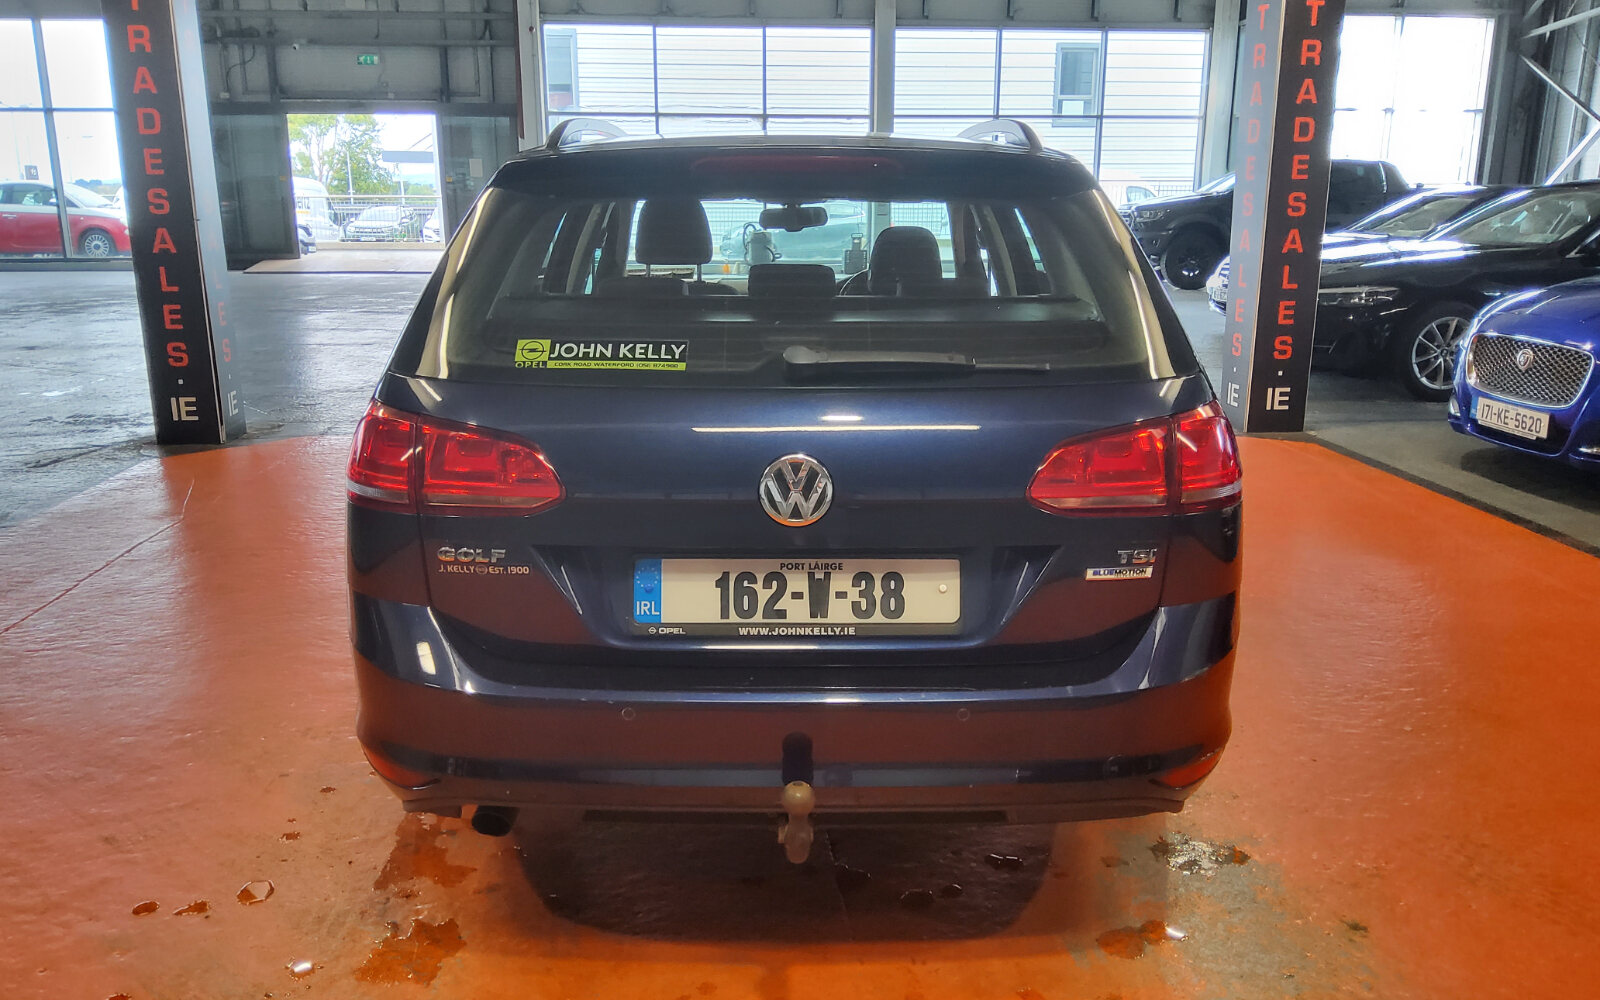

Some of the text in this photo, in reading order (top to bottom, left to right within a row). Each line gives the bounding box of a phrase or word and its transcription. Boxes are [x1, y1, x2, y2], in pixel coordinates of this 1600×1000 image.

[550, 343, 686, 359] JOHN KELLY
[515, 361, 545, 369] OPEL
[1481, 403, 1542, 433] 171-KE-5620
[437, 546, 506, 563] GOLF
[1117, 548, 1157, 564] TSI
[439, 564, 446, 573] J.
[447, 565, 475, 573] KELLY
[508, 566, 530, 574] 1900
[780, 561, 843, 571] PORT LÁIRGE
[715, 571, 906, 620] 162-W-38
[636, 601, 660, 616] IRL
[658, 627, 686, 635] OPEL
[738, 627, 856, 636] WWW.JOHNKELLY.IE
